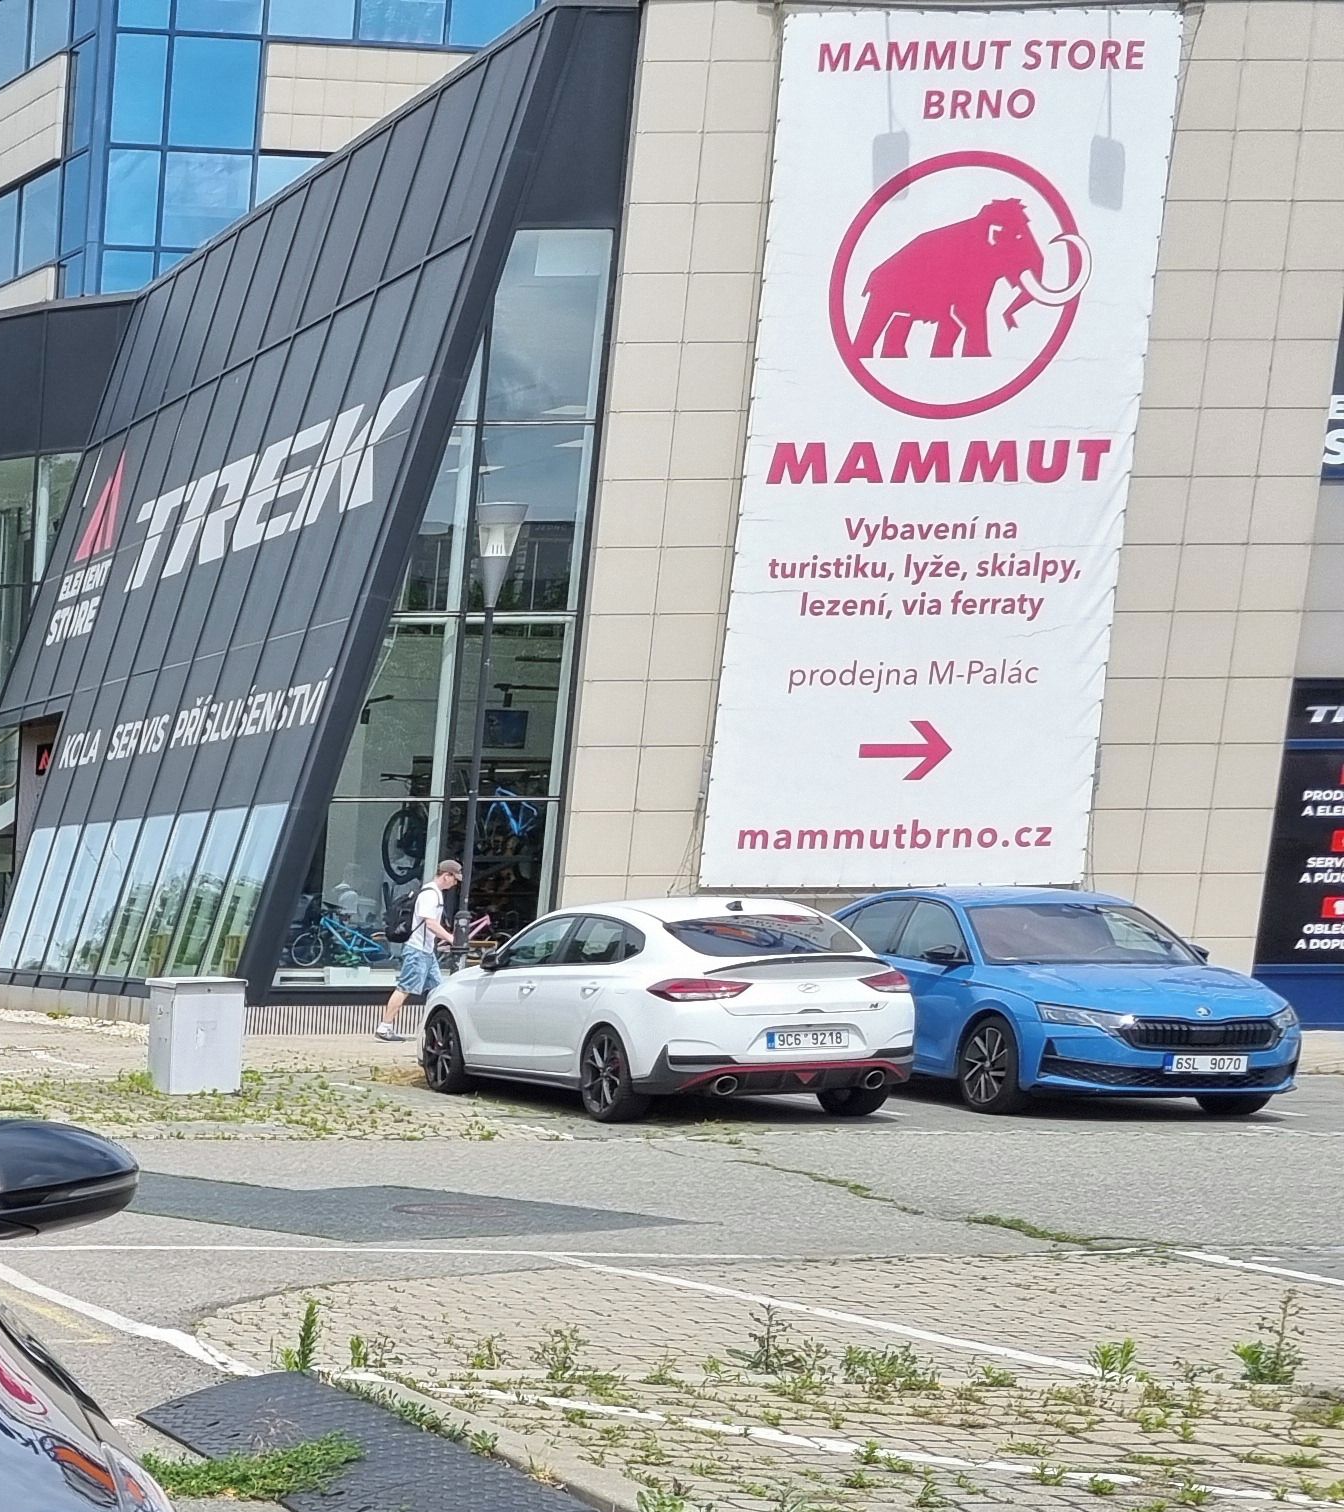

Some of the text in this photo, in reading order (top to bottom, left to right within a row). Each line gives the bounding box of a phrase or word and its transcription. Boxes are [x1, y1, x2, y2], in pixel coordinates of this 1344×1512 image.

[817, 39, 1147, 73] MAMMUT STORE
[922, 88, 1037, 120] BRNO
[766, 439, 1112, 485] MAMMUT
[124, 375, 426, 592] TREK
[845, 516, 1018, 547] Vybavení na
[768, 552, 1082, 585] turistiku, lyže, skialpy,
[800, 591, 1045, 621] lezení, via ferraty
[788, 659, 1040, 693] prodejna M-Palác
[59, 729, 102, 769] KOLA
[106, 714, 170, 760] SERVIS
[1301, 805, 1344, 817] A ELE
[1302, 790, 1344, 801] PROD
[737, 819, 1053, 851] mammutbrno.cz
[1299, 873, 1312, 883] A
[1306, 857, 1344, 868] SERV
[1294, 939, 1307, 949] A
[778, 1033, 801, 1046] 9C6
[811, 1032, 843, 1045] 9218
[1175, 1057, 1241, 1070] 6SL 9070
